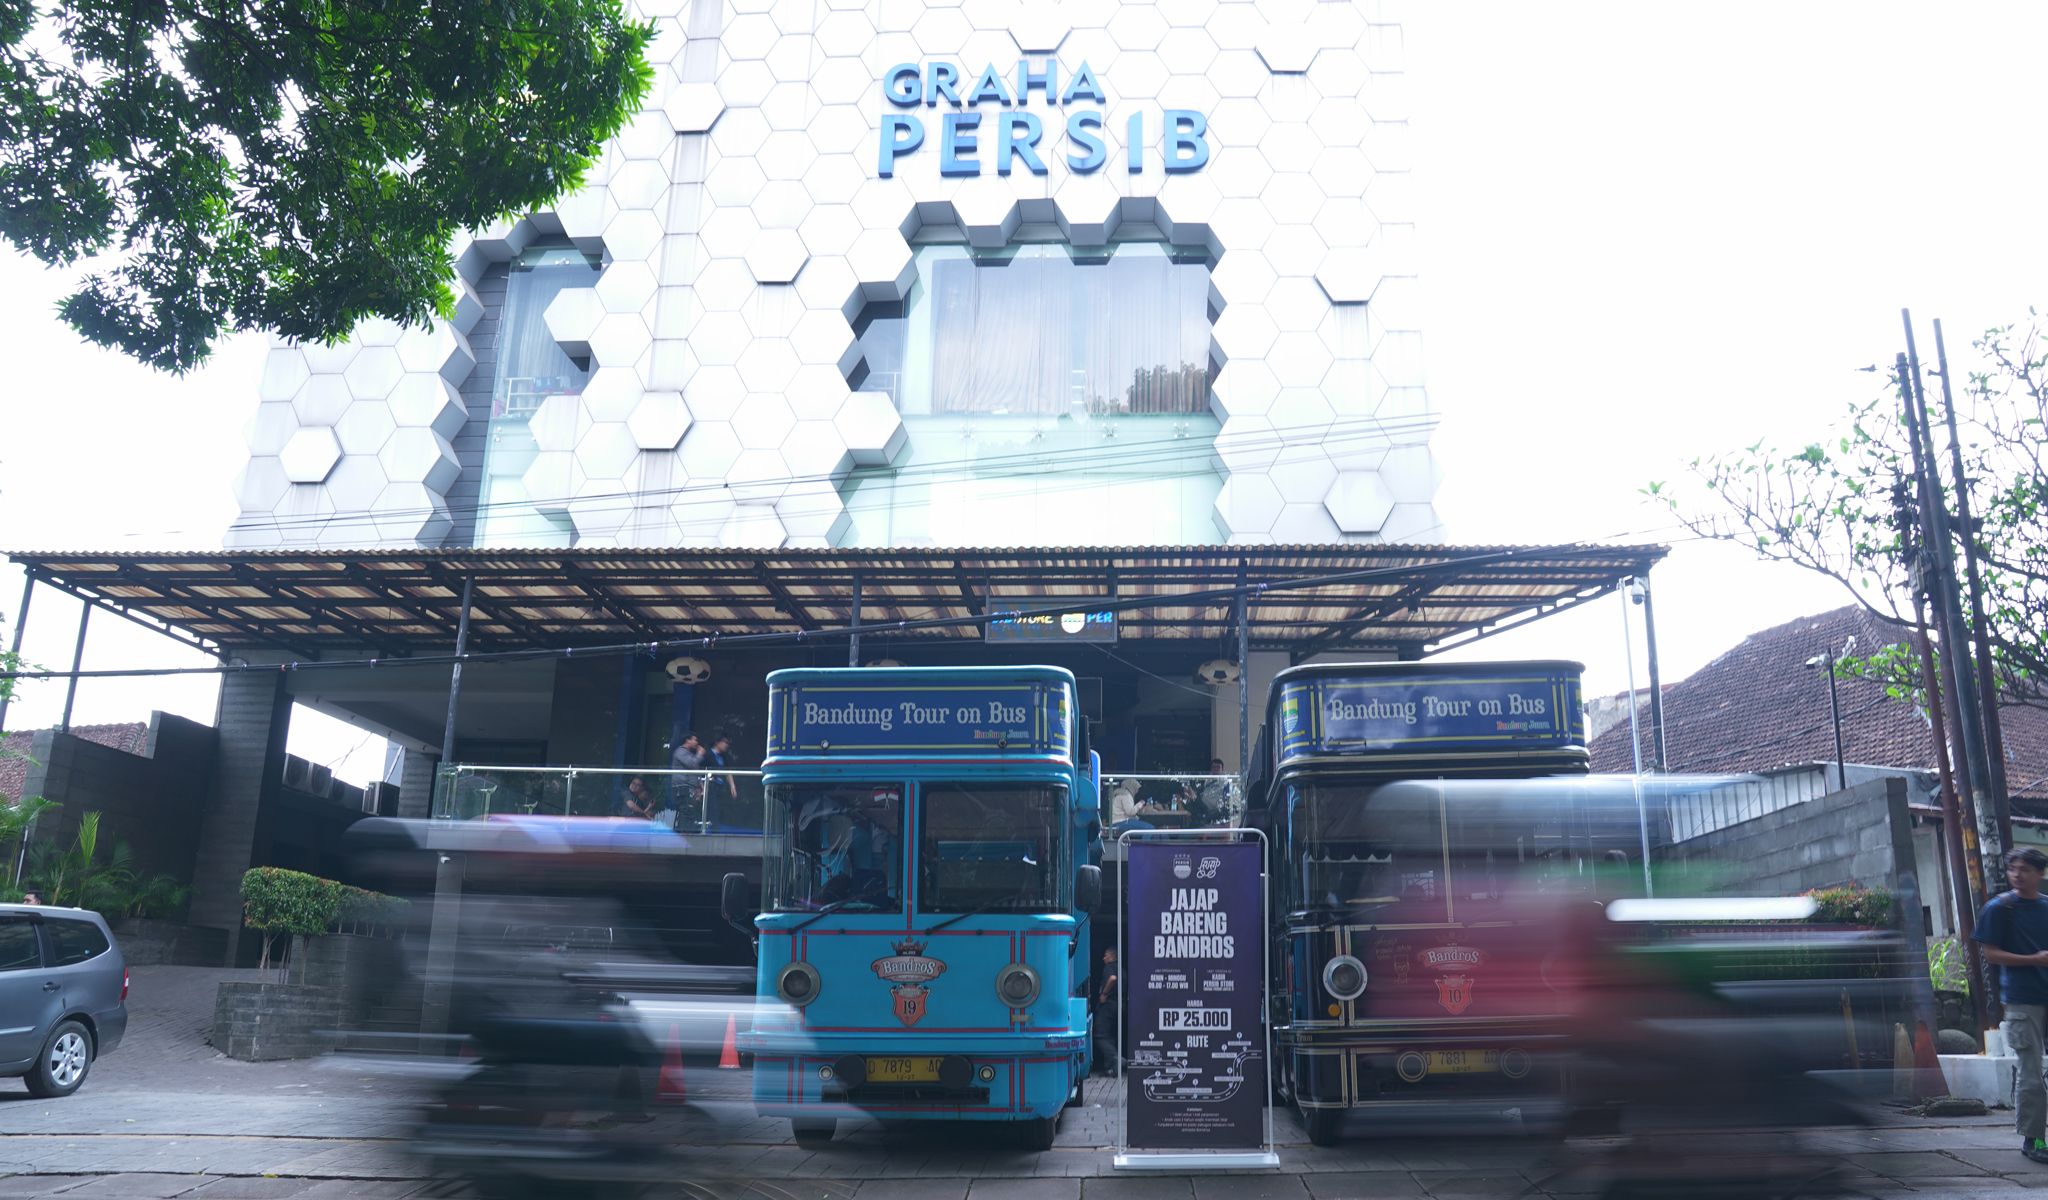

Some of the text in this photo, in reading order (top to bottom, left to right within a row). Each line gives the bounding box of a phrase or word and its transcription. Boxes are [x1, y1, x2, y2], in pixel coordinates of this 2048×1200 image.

[883, 59, 1106, 108] GRAHA
[878, 110, 1210, 178] PERSIB
[804, 701, 1026, 731] Bandung Tour on Bus
[1329, 693, 1545, 725] Bandung Tour on Bus
[1170, 888, 1219, 911] JAJAP
[1161, 911, 1228, 935] BARENG
[1154, 935, 1235, 959] BANDROS
[1427, 950, 1480, 964] Bandros
[882, 957, 936, 976] Bandros
[903, 999, 917, 1015] 19
[1163, 1011, 1229, 1027] RP 25.000
[1187, 1035, 1209, 1048] RUTE
[868, 1059, 876, 1073] D
[883, 1059, 912, 1073] 7879
